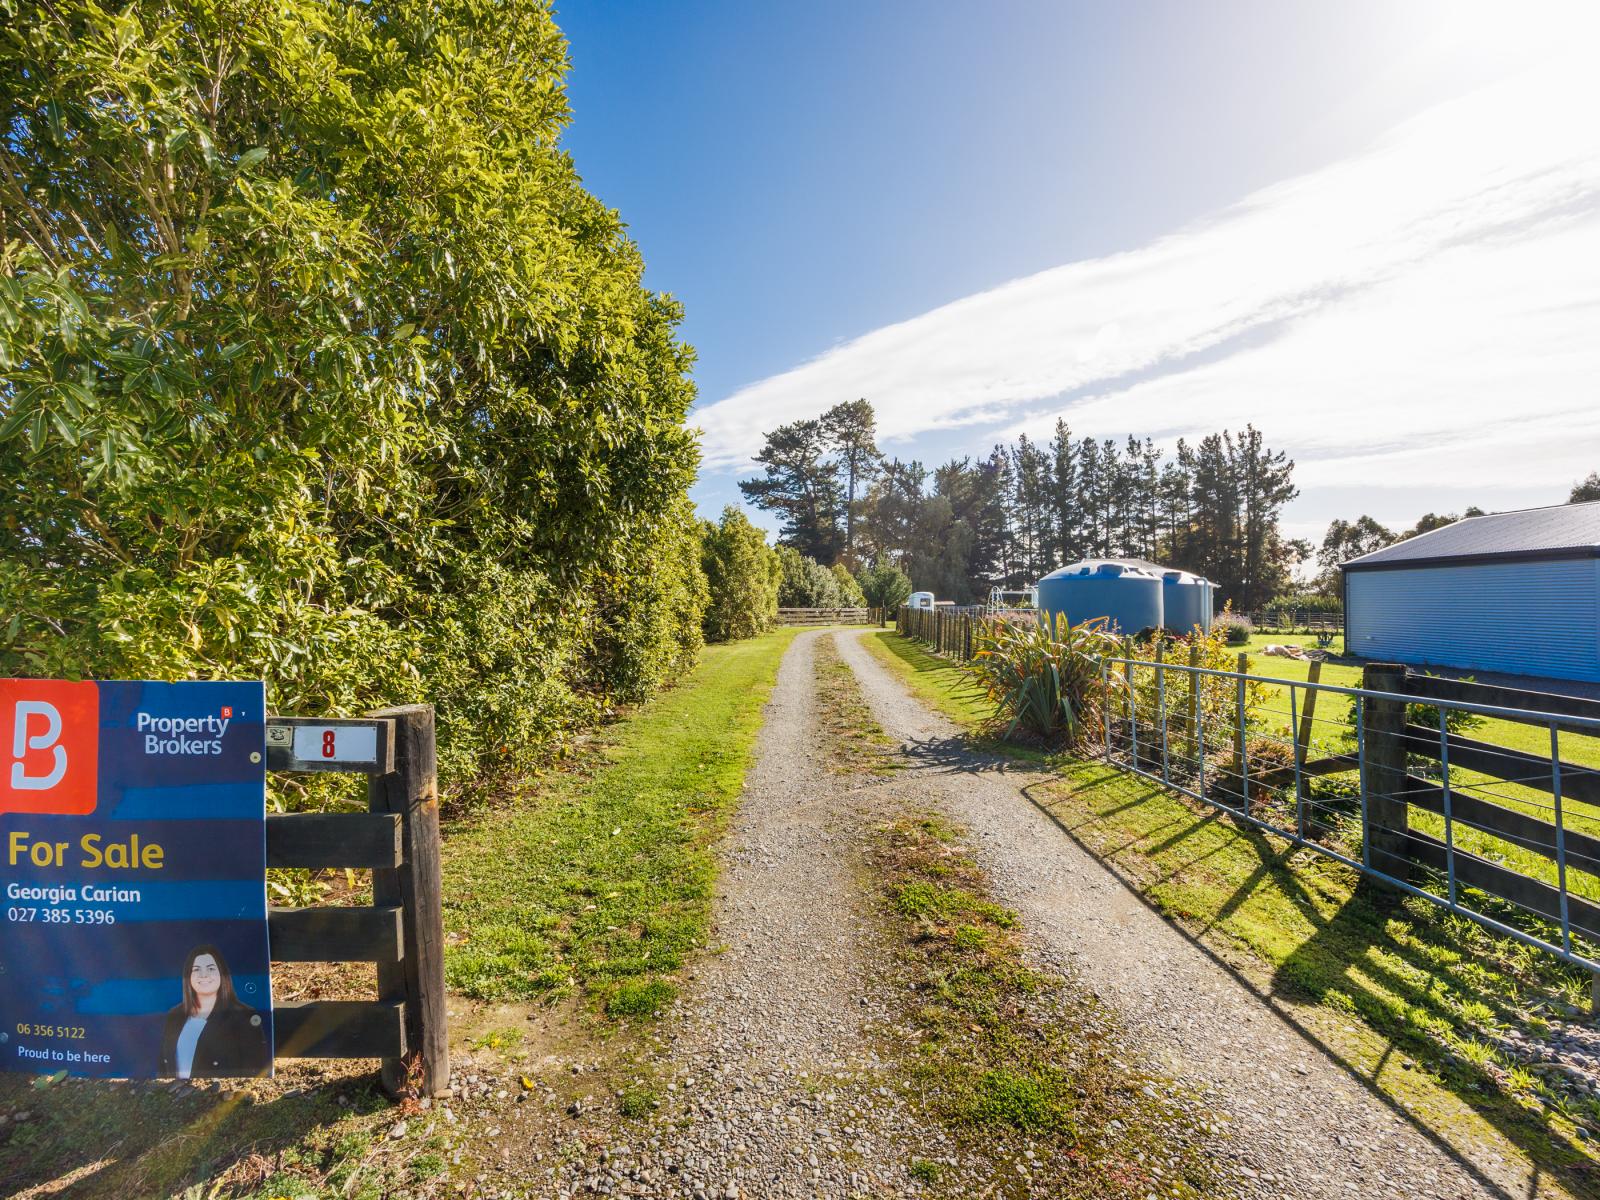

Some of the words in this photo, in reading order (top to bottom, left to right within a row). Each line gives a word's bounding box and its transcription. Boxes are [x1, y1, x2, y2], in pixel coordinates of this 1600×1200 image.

[137, 712, 229, 738] Property
[145, 734, 222, 755] Brokers
[322, 730, 335, 758] 8
[9, 831, 69, 867] For
[80, 833, 165, 869] Sale
[7, 883, 77, 905] Georgia
[81, 885, 141, 902] Carian
[8, 907, 37, 922] 027
[42, 908, 71, 924] 385
[75, 909, 115, 925] 5396
[17, 1023, 31, 1035] 06
[33, 1025, 54, 1037] 356
[57, 1026, 85, 1039] 5122
[18, 1046, 49, 1060] Proud
[52, 1050, 64, 1061] to
[67, 1050, 81, 1062] be
[84, 1051, 110, 1063] here
